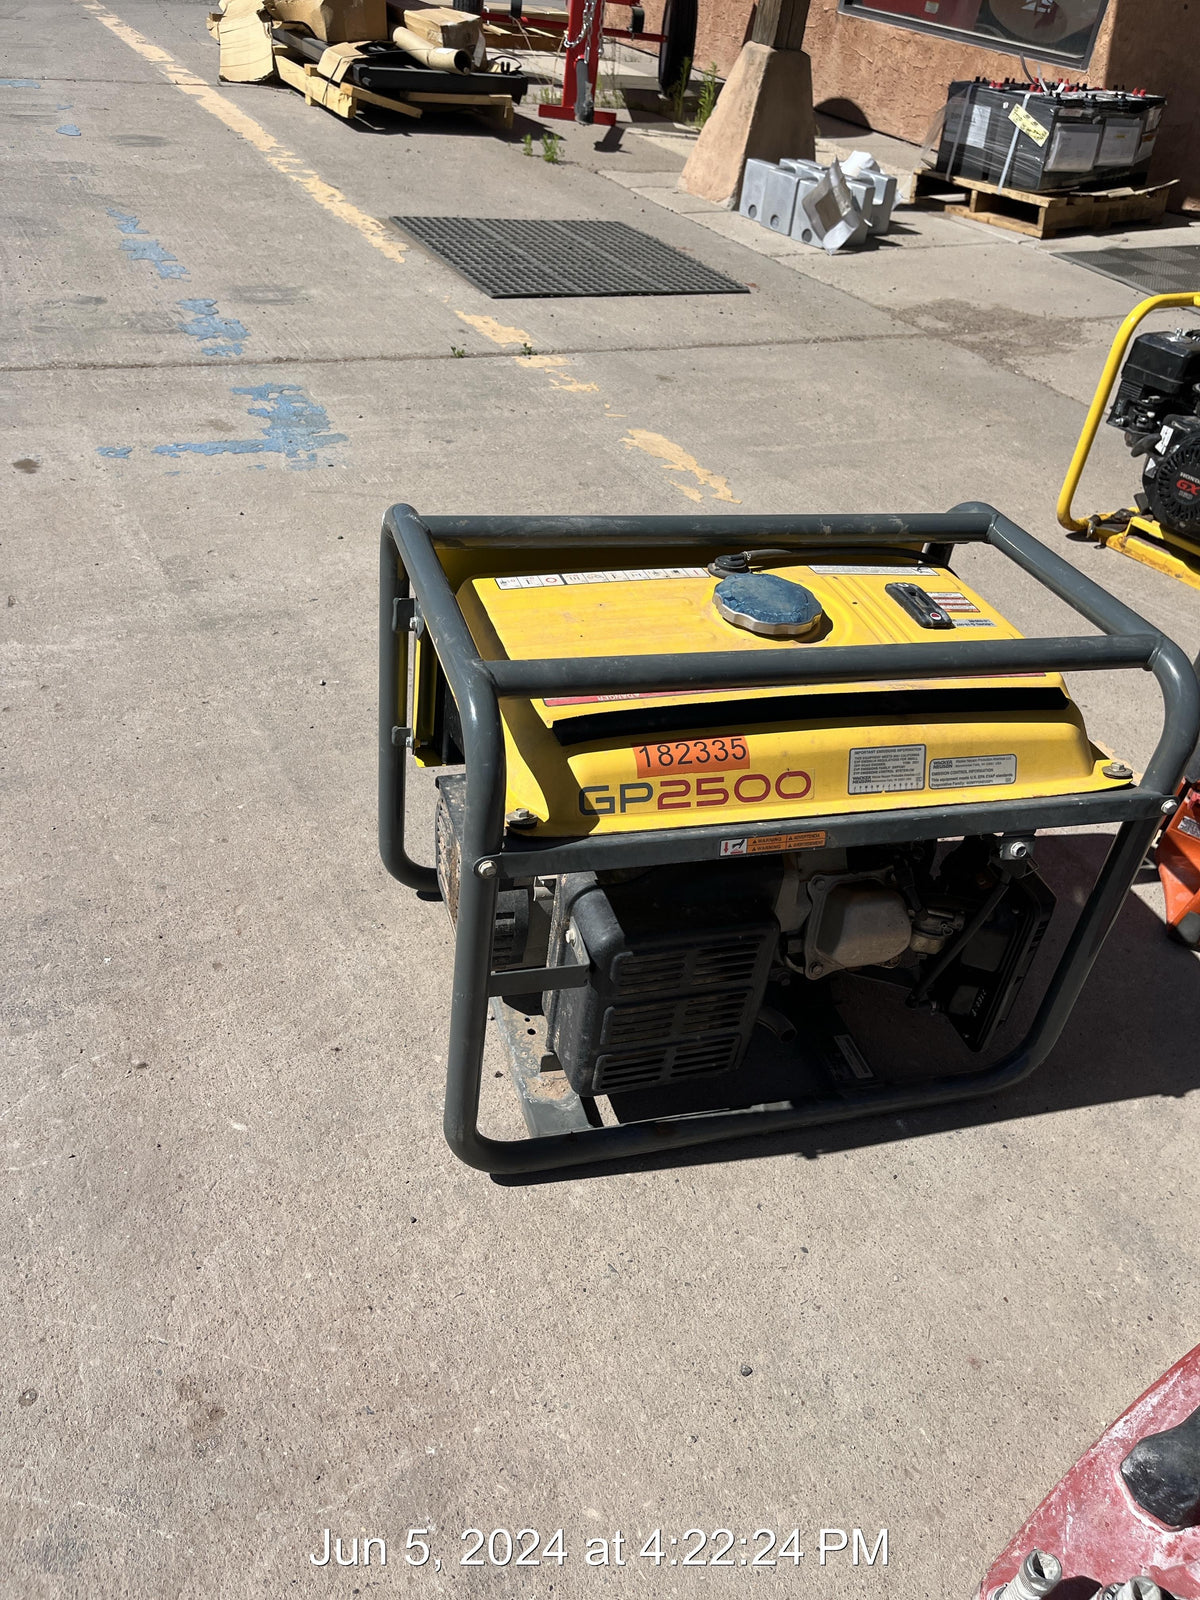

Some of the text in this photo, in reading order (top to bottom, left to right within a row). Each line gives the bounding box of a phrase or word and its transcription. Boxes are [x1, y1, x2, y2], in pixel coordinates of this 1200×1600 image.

[1176, 480, 1200, 495] GX
[1180, 472, 1200, 484] HOND
[638, 738, 747, 768] 182335
[578, 770, 812, 816] GP2500
